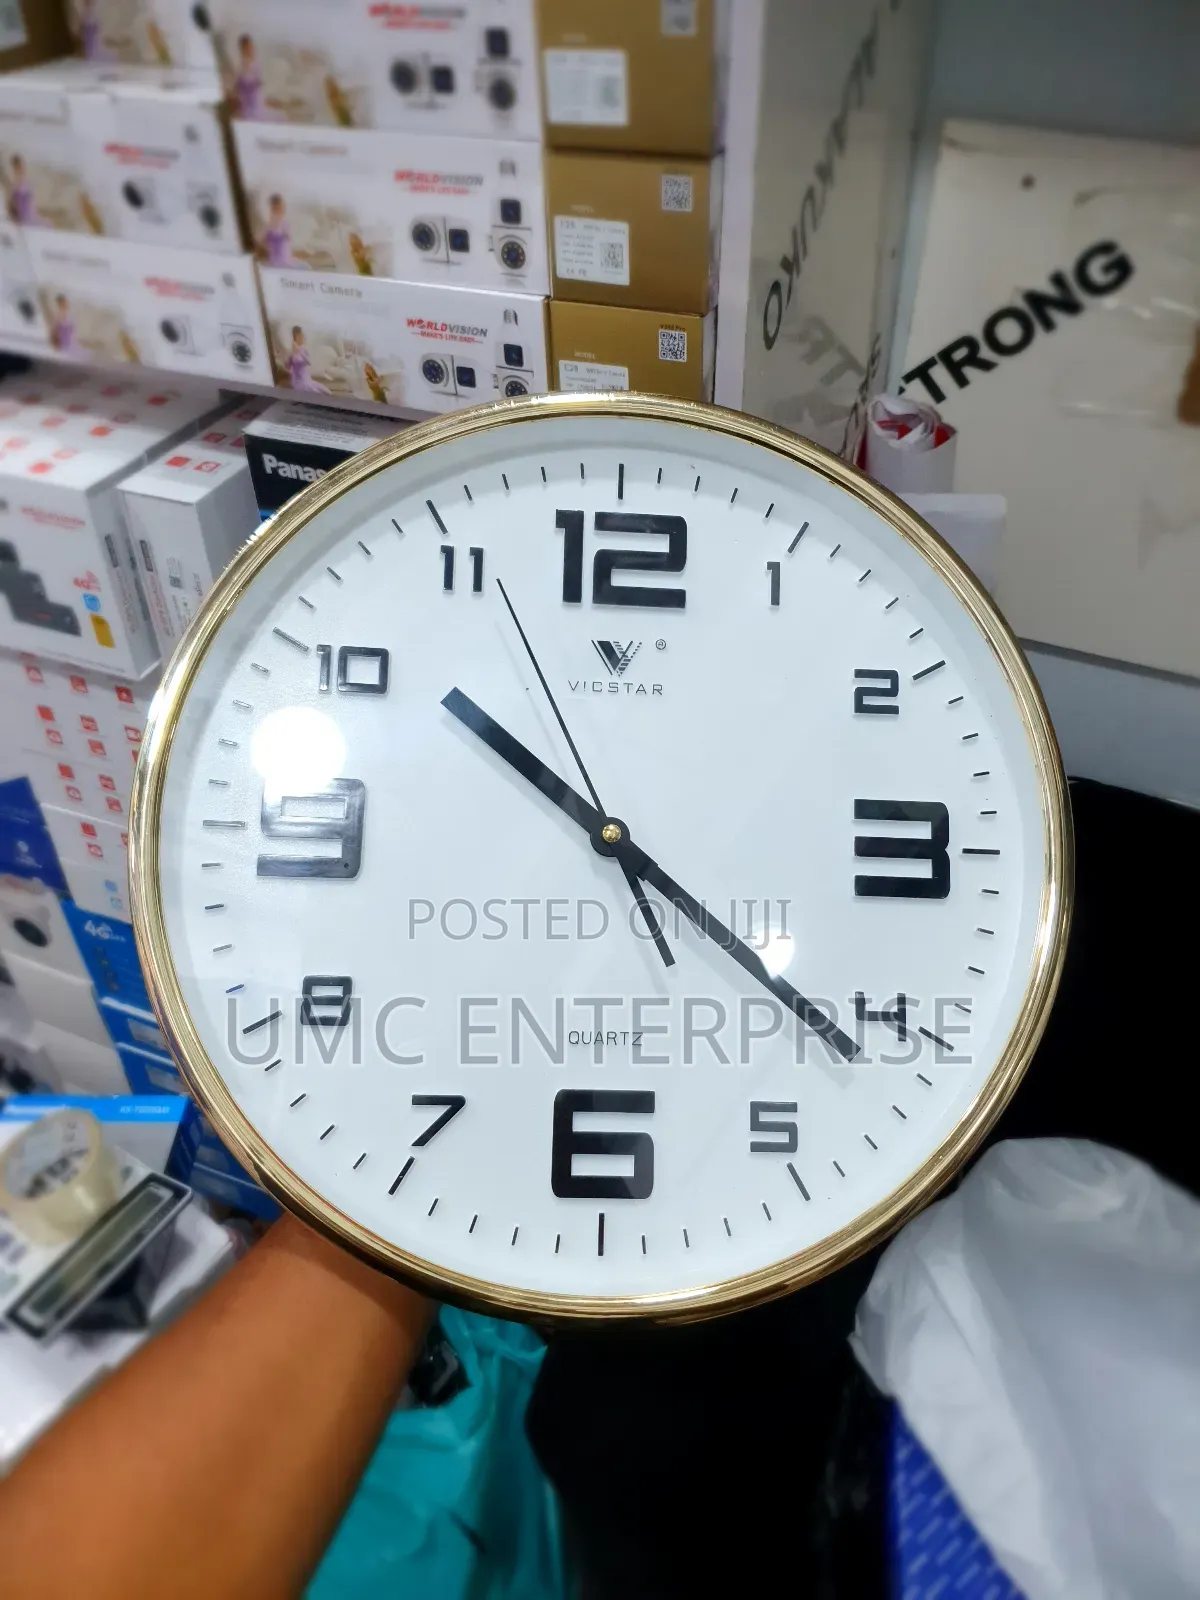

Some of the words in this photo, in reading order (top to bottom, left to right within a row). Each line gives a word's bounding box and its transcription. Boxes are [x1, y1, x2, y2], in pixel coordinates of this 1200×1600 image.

[406, 318, 488, 337] WORLDVISION
[898, 240, 1135, 404] TRONG
[440, 545, 485, 593] 11
[555, 508, 688, 608] 12
[766, 561, 781, 606] 1
[316, 644, 390, 694] 10
[567, 680, 664, 696] VICSTAR
[854, 668, 900, 715] 2
[257, 777, 365, 879] 9
[854, 799, 950, 900] 3
[300, 975, 353, 1026] 8
[854, 991, 907, 1043] 4
[568, 1030, 644, 1048] QUARTZ
[411, 1094, 467, 1147] 7
[551, 1089, 656, 1200] 6
[749, 1101, 799, 1153] 5
